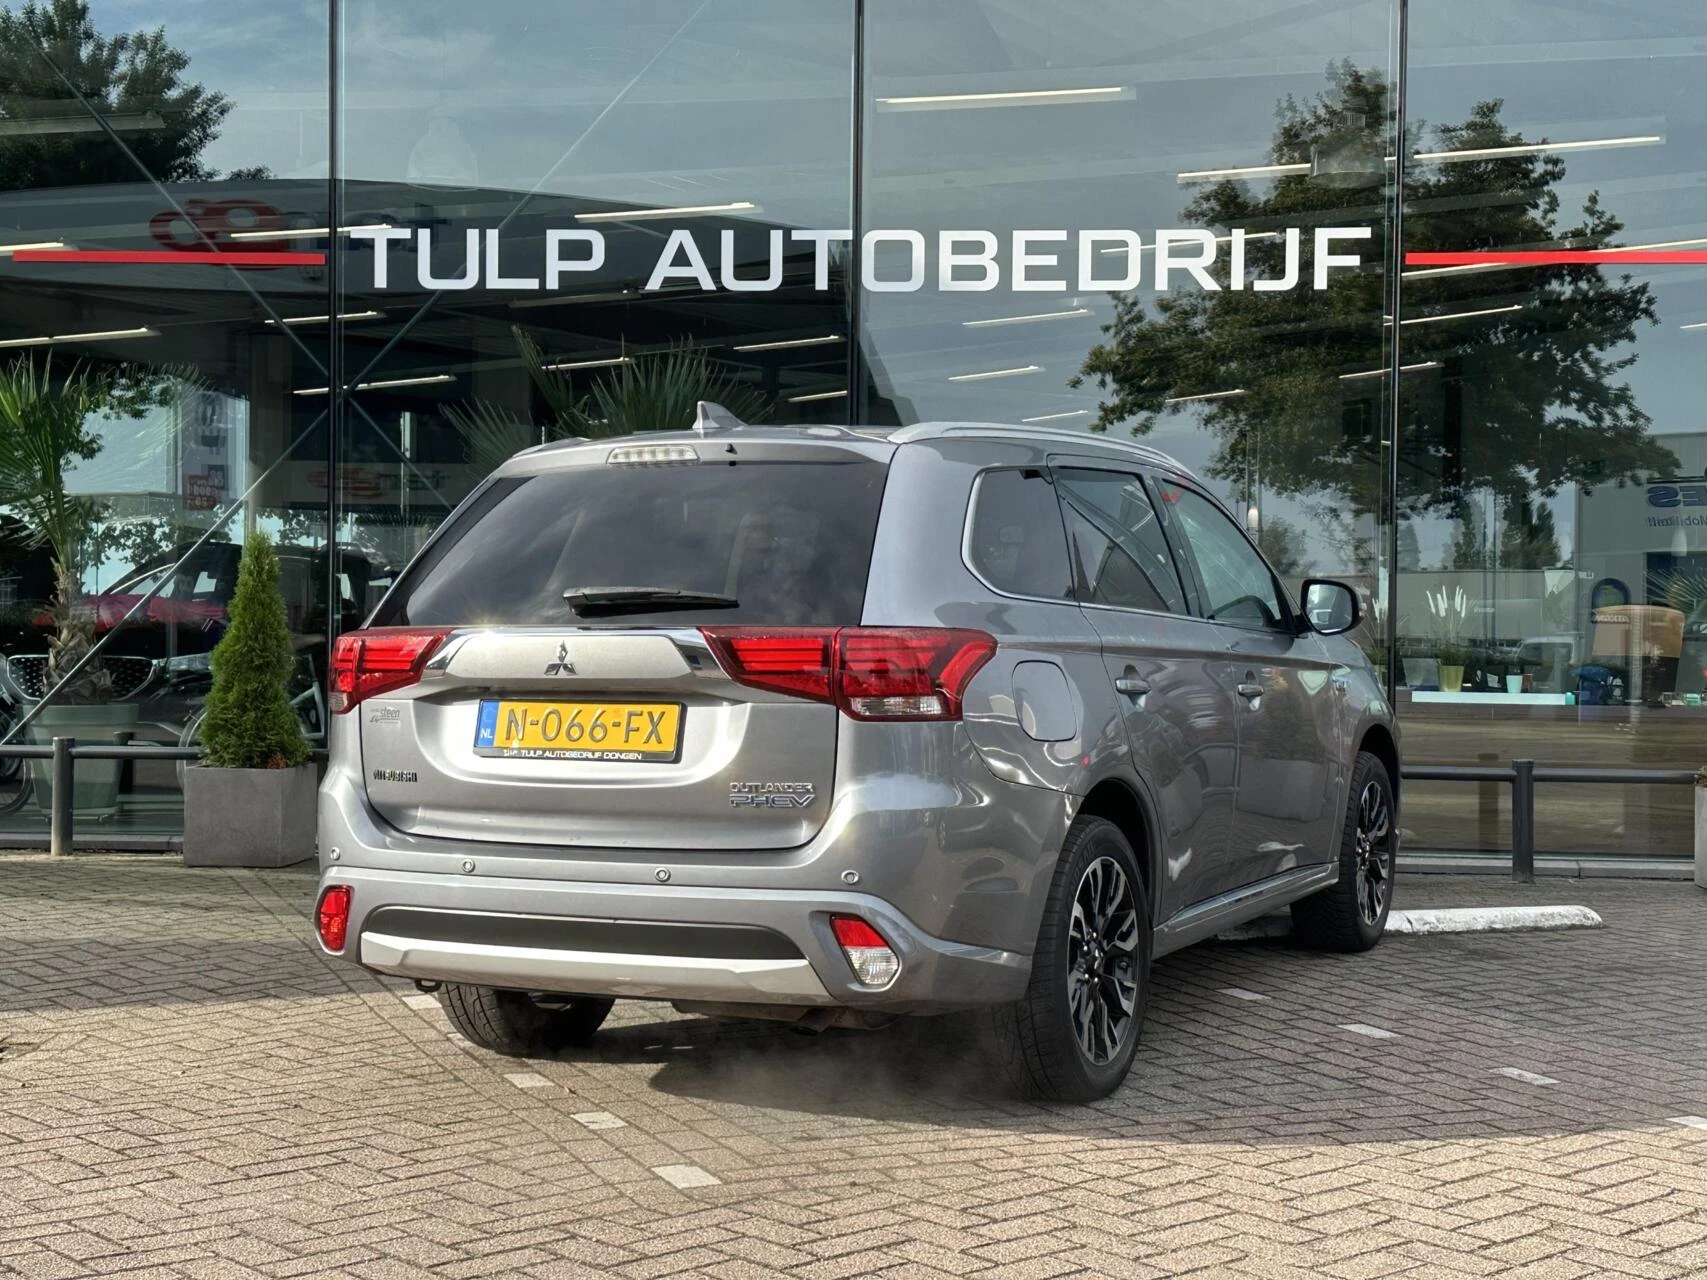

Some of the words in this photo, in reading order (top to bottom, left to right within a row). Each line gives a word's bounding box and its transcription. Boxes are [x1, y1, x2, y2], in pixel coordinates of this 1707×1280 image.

[350, 228, 605, 290] TULP
[645, 227, 1371, 292] AUTOBEDRIJF
[505, 708, 666, 744] N-066-FX
[480, 728, 493, 738] NL
[603, 752, 642, 760] DONGEN
[729, 782, 813, 792] OUTLANDER
[729, 793, 815, 808] PHEV
